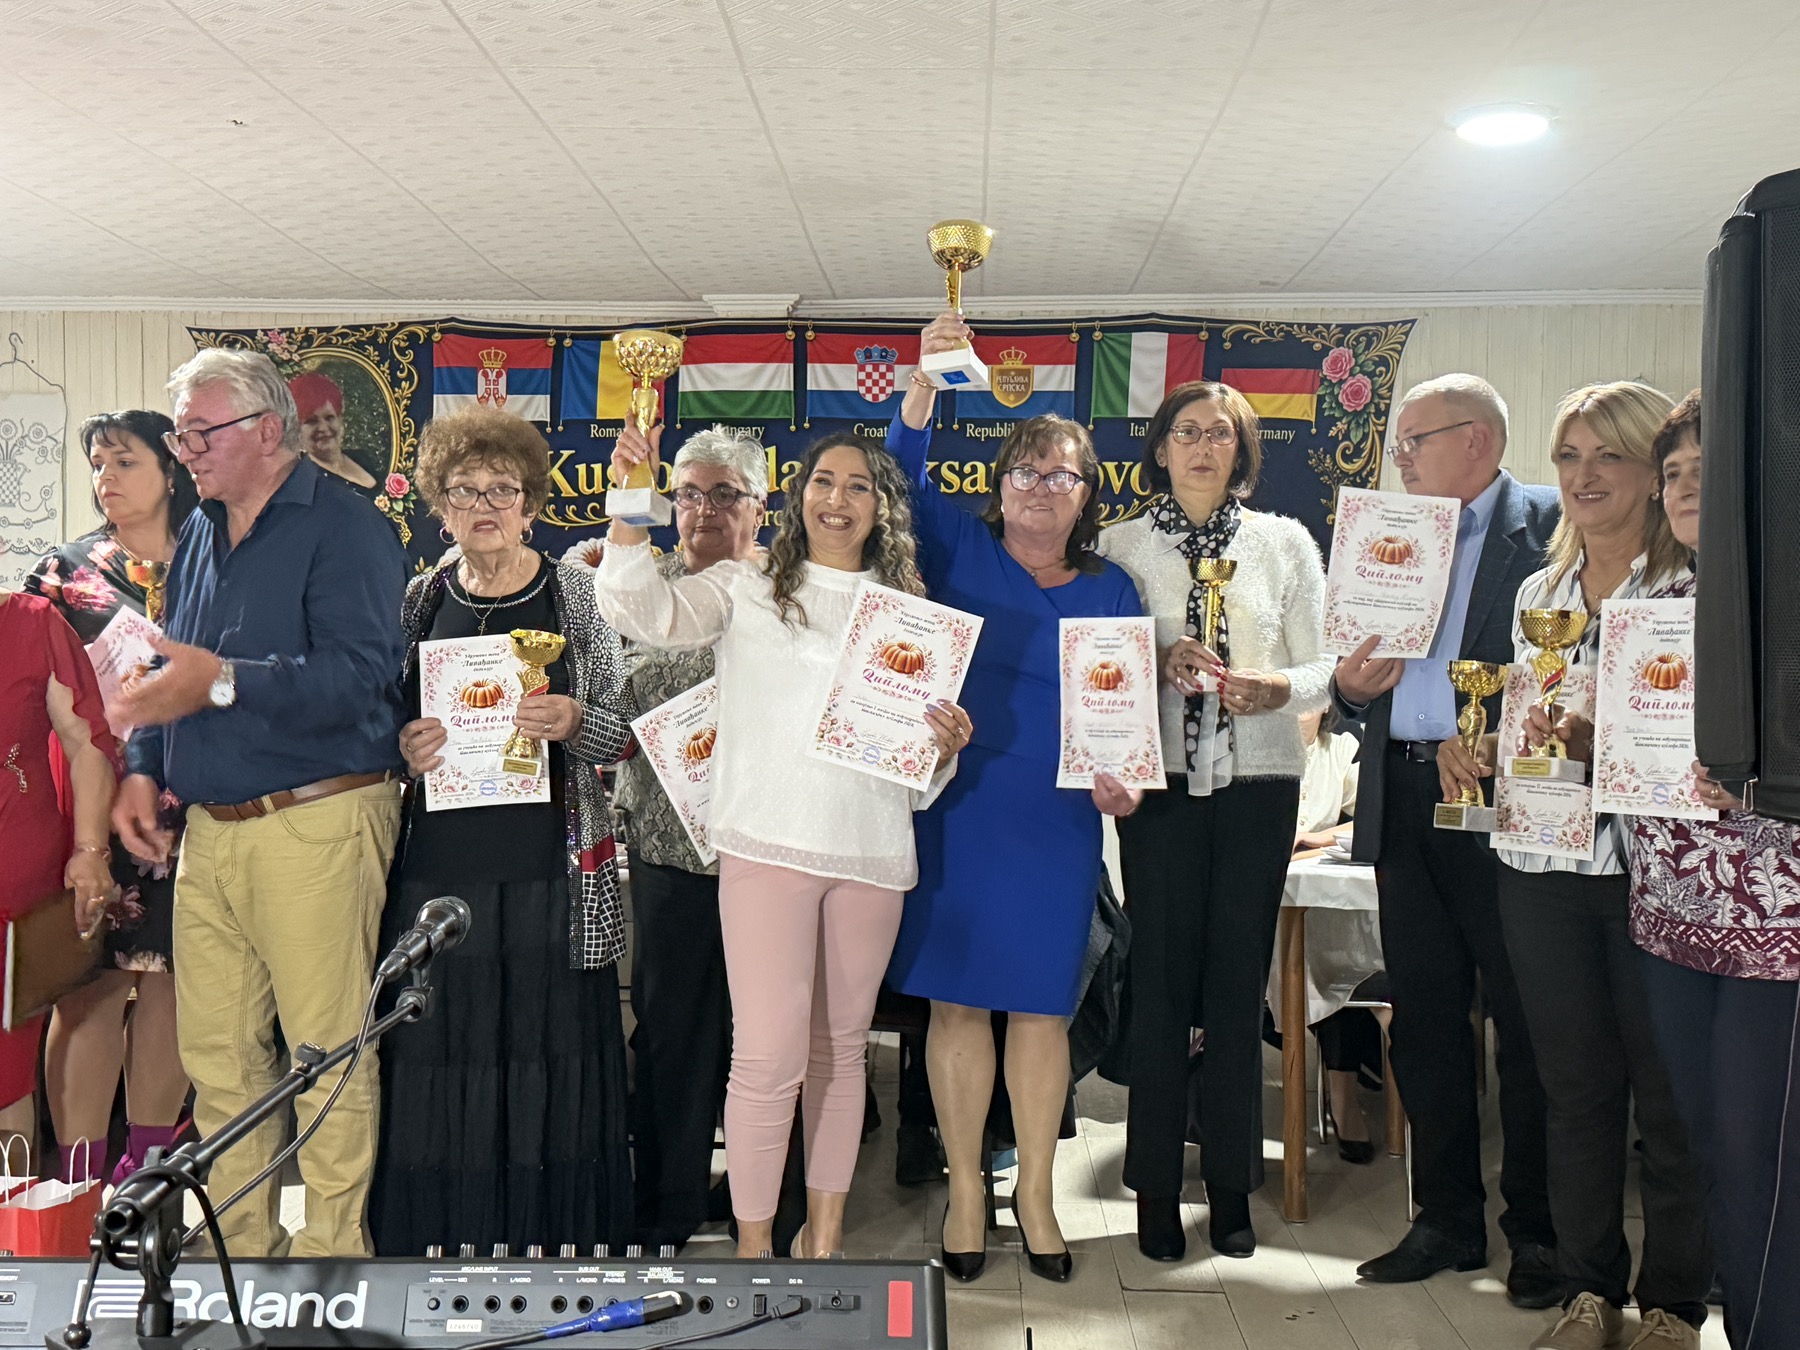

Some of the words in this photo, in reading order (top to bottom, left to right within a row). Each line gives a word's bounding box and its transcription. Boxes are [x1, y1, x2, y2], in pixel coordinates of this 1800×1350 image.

[998, 383, 1026, 392] СРПСКА
[590, 424, 622, 438] Roma
[853, 422, 889, 438] Croat
[966, 422, 1016, 442] Republi
[1129, 421, 1150, 437] Ital
[1257, 429, 1296, 445] rmany
[862, 667, 931, 700] Диплому
[170, 1279, 369, 1330] Roland
